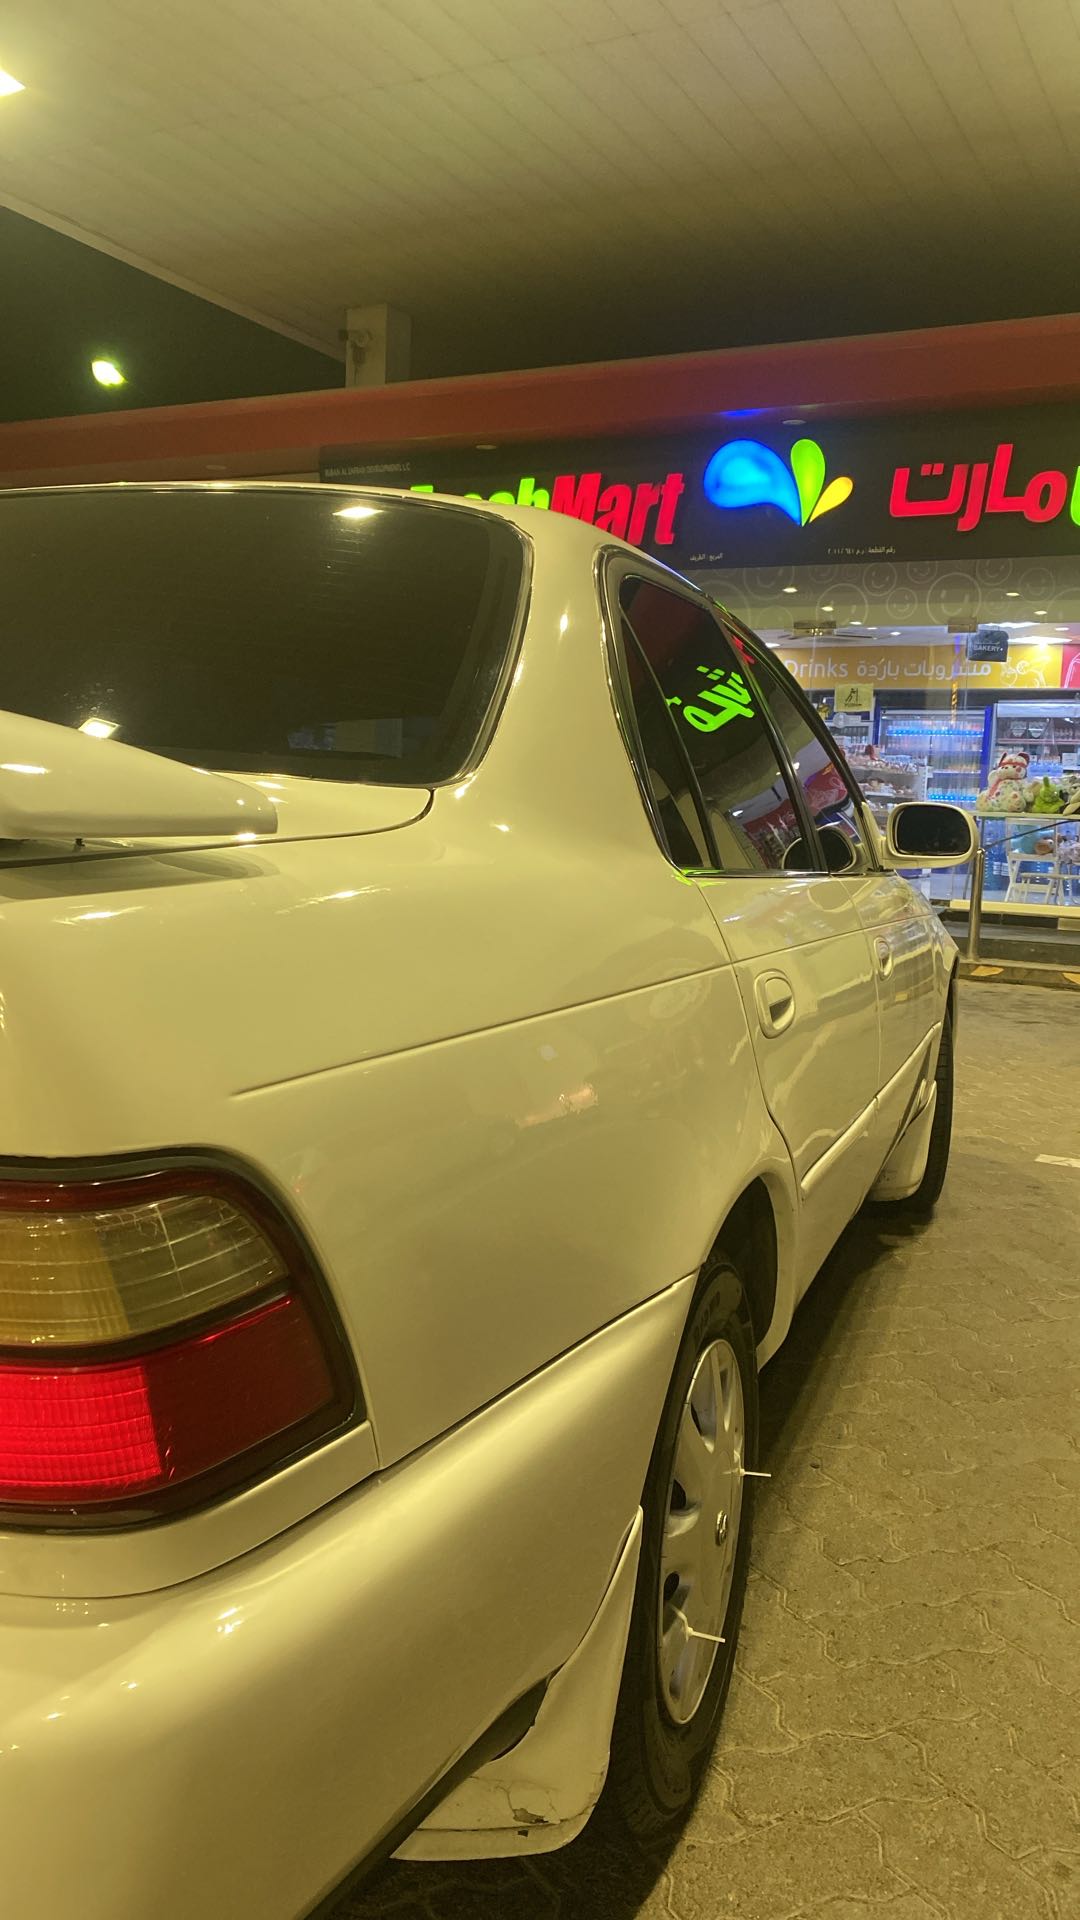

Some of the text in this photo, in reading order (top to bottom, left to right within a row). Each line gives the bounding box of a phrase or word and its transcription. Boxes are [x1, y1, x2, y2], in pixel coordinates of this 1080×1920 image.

[889, 443, 1068, 532] مارت
[973, 645, 1000, 654] BAKERY
[784, 657, 848, 679] Drinks
